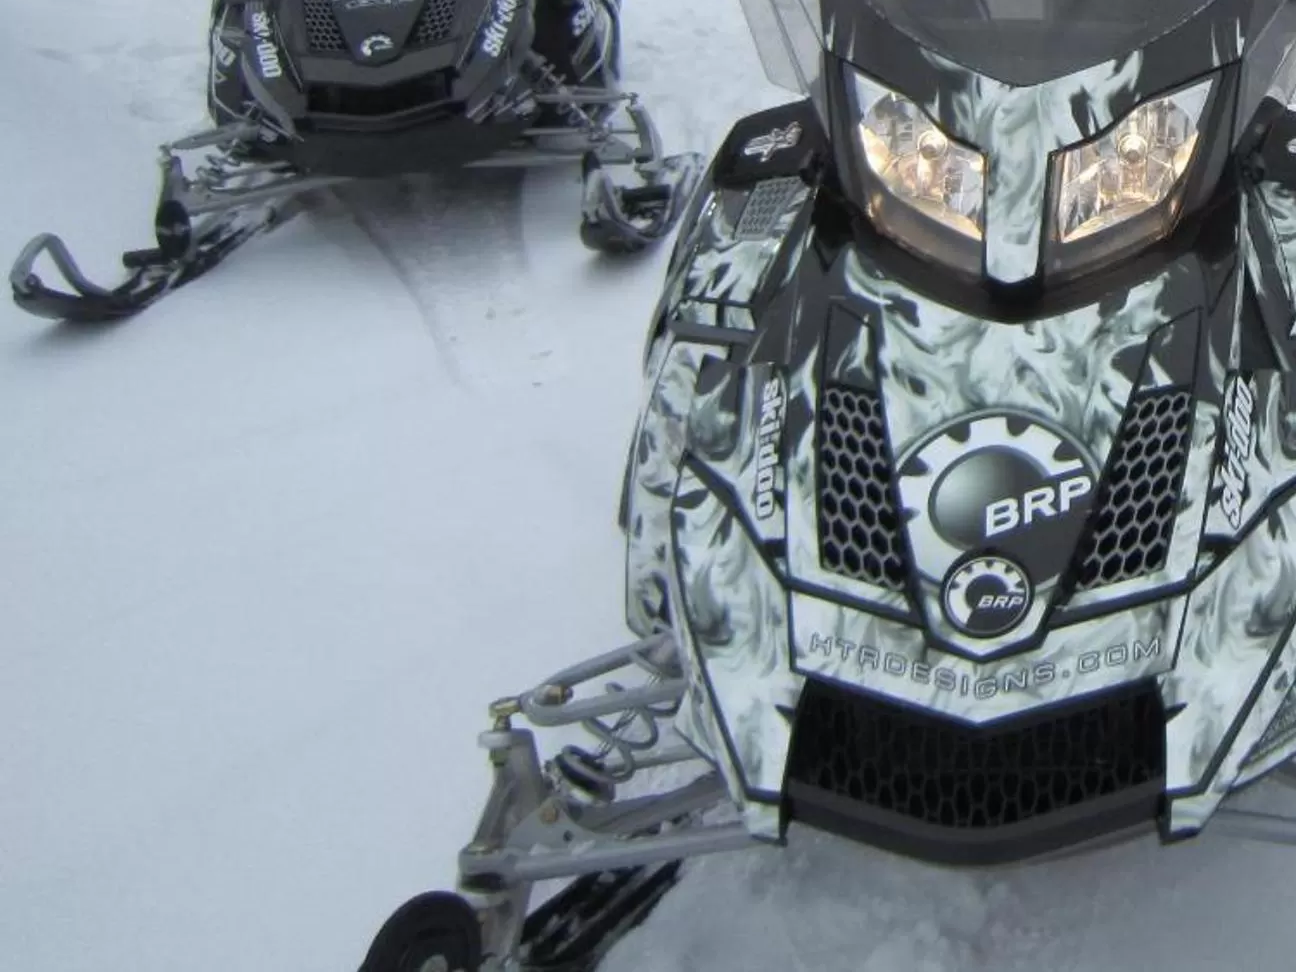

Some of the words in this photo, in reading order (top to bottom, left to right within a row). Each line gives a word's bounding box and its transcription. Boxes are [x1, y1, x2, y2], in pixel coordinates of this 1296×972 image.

[756, 378, 783, 520] ski-doo
[1221, 375, 1254, 530] ski-doo
[985, 475, 1092, 538] BRP
[977, 594, 1024, 609] BRP
[809, 631, 1162, 700] HTRDESIGNS.COM
